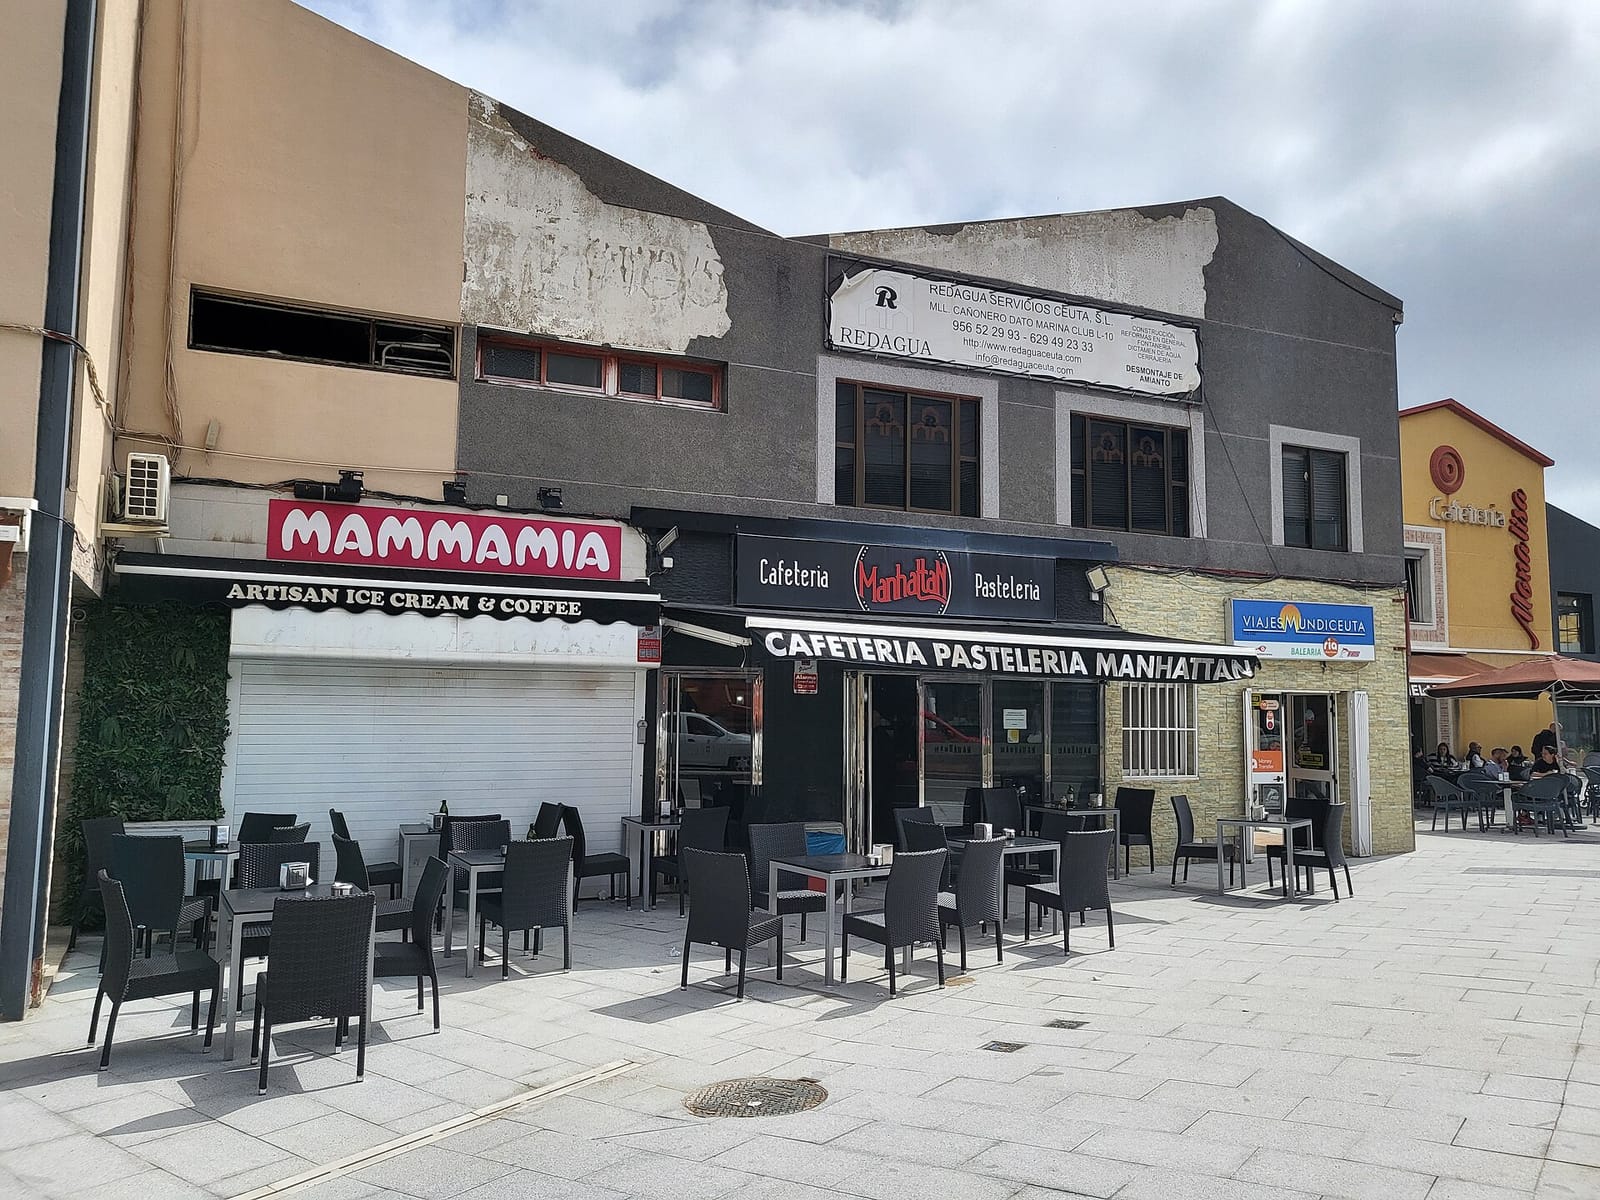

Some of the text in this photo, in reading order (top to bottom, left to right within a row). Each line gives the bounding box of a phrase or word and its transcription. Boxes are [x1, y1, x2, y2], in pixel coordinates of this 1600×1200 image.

[929, 284, 987, 304] REDAGUA
[989, 294, 1051, 315] SERVICIOS
[1053, 305, 1092, 324] CEUTA,
[929, 301, 1114, 341] MLL. CAÑONERO DATO MARINA CLUB L-10
[840, 326, 933, 356] REDAGUA
[952, 319, 973, 333] 956
[975, 323, 989, 336] 52
[991, 326, 1005, 338] 29
[1007, 328, 1020, 341] 93
[1030, 332, 1049, 345] 629
[1051, 336, 1064, 348] 49
[1066, 338, 1079, 350] 23
[1081, 341, 1094, 353] 33
[963, 337, 1082, 363] http://www.redaguaceuta.com
[1120, 329, 1152, 342] REFORMAS
[1161, 337, 1187, 348] GENERAL
[975, 352, 1074, 375] info@redaguaceuta.com
[1127, 344, 1156, 355] DICTAMEN
[1165, 350, 1181, 359] AGUA
[1126, 364, 1183, 381] DESMONTAJE DE
[1140, 375, 1171, 387] AMIANTO
[281, 508, 611, 572] MAMMAMIA
[760, 558, 829, 589] Cafeteria
[975, 573, 1041, 601] Pasteleria
[226, 583, 582, 616] ARTISAN ICE CREAM & COFFEE
[764, 631, 1253, 681] CAFETERIA PASTELERIA MANHATTAN
[1323, 638, 1338, 651] ria
